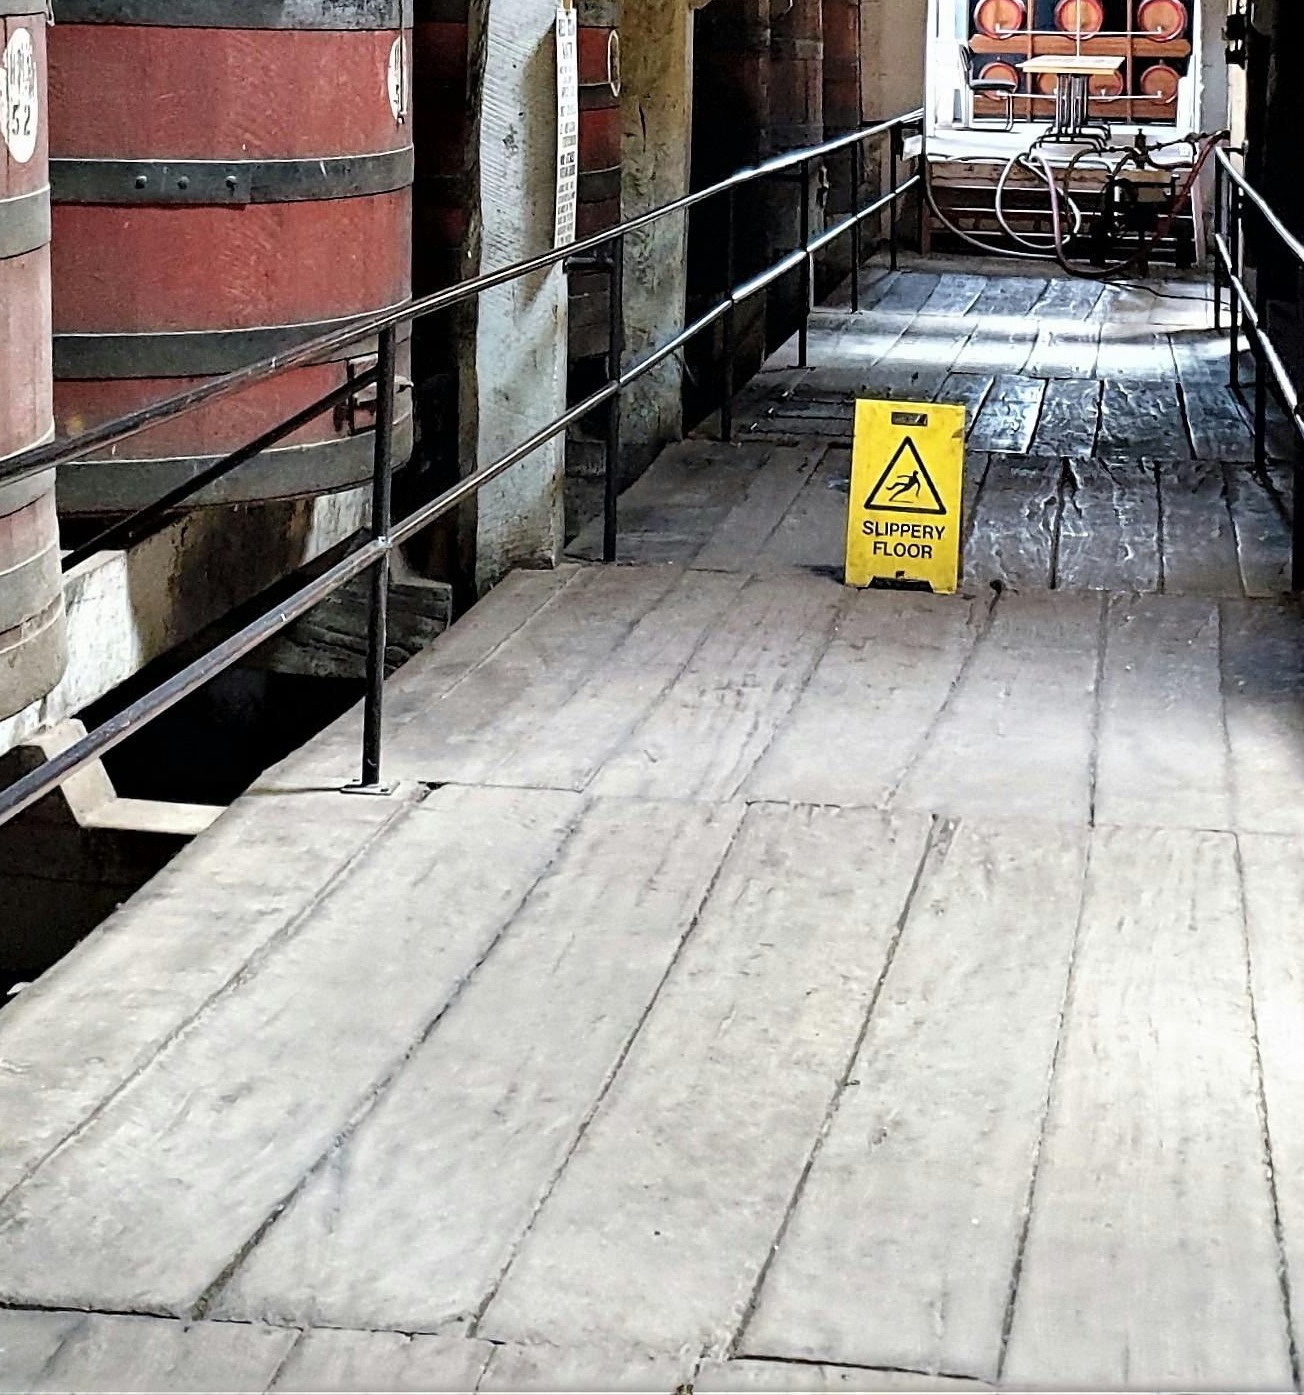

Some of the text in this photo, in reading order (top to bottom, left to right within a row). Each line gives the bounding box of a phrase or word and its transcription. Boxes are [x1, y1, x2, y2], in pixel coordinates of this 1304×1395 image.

[12, 104, 31, 136] 52
[862, 520, 946, 541] SLIPPERY
[872, 541, 933, 559] FLOOR
